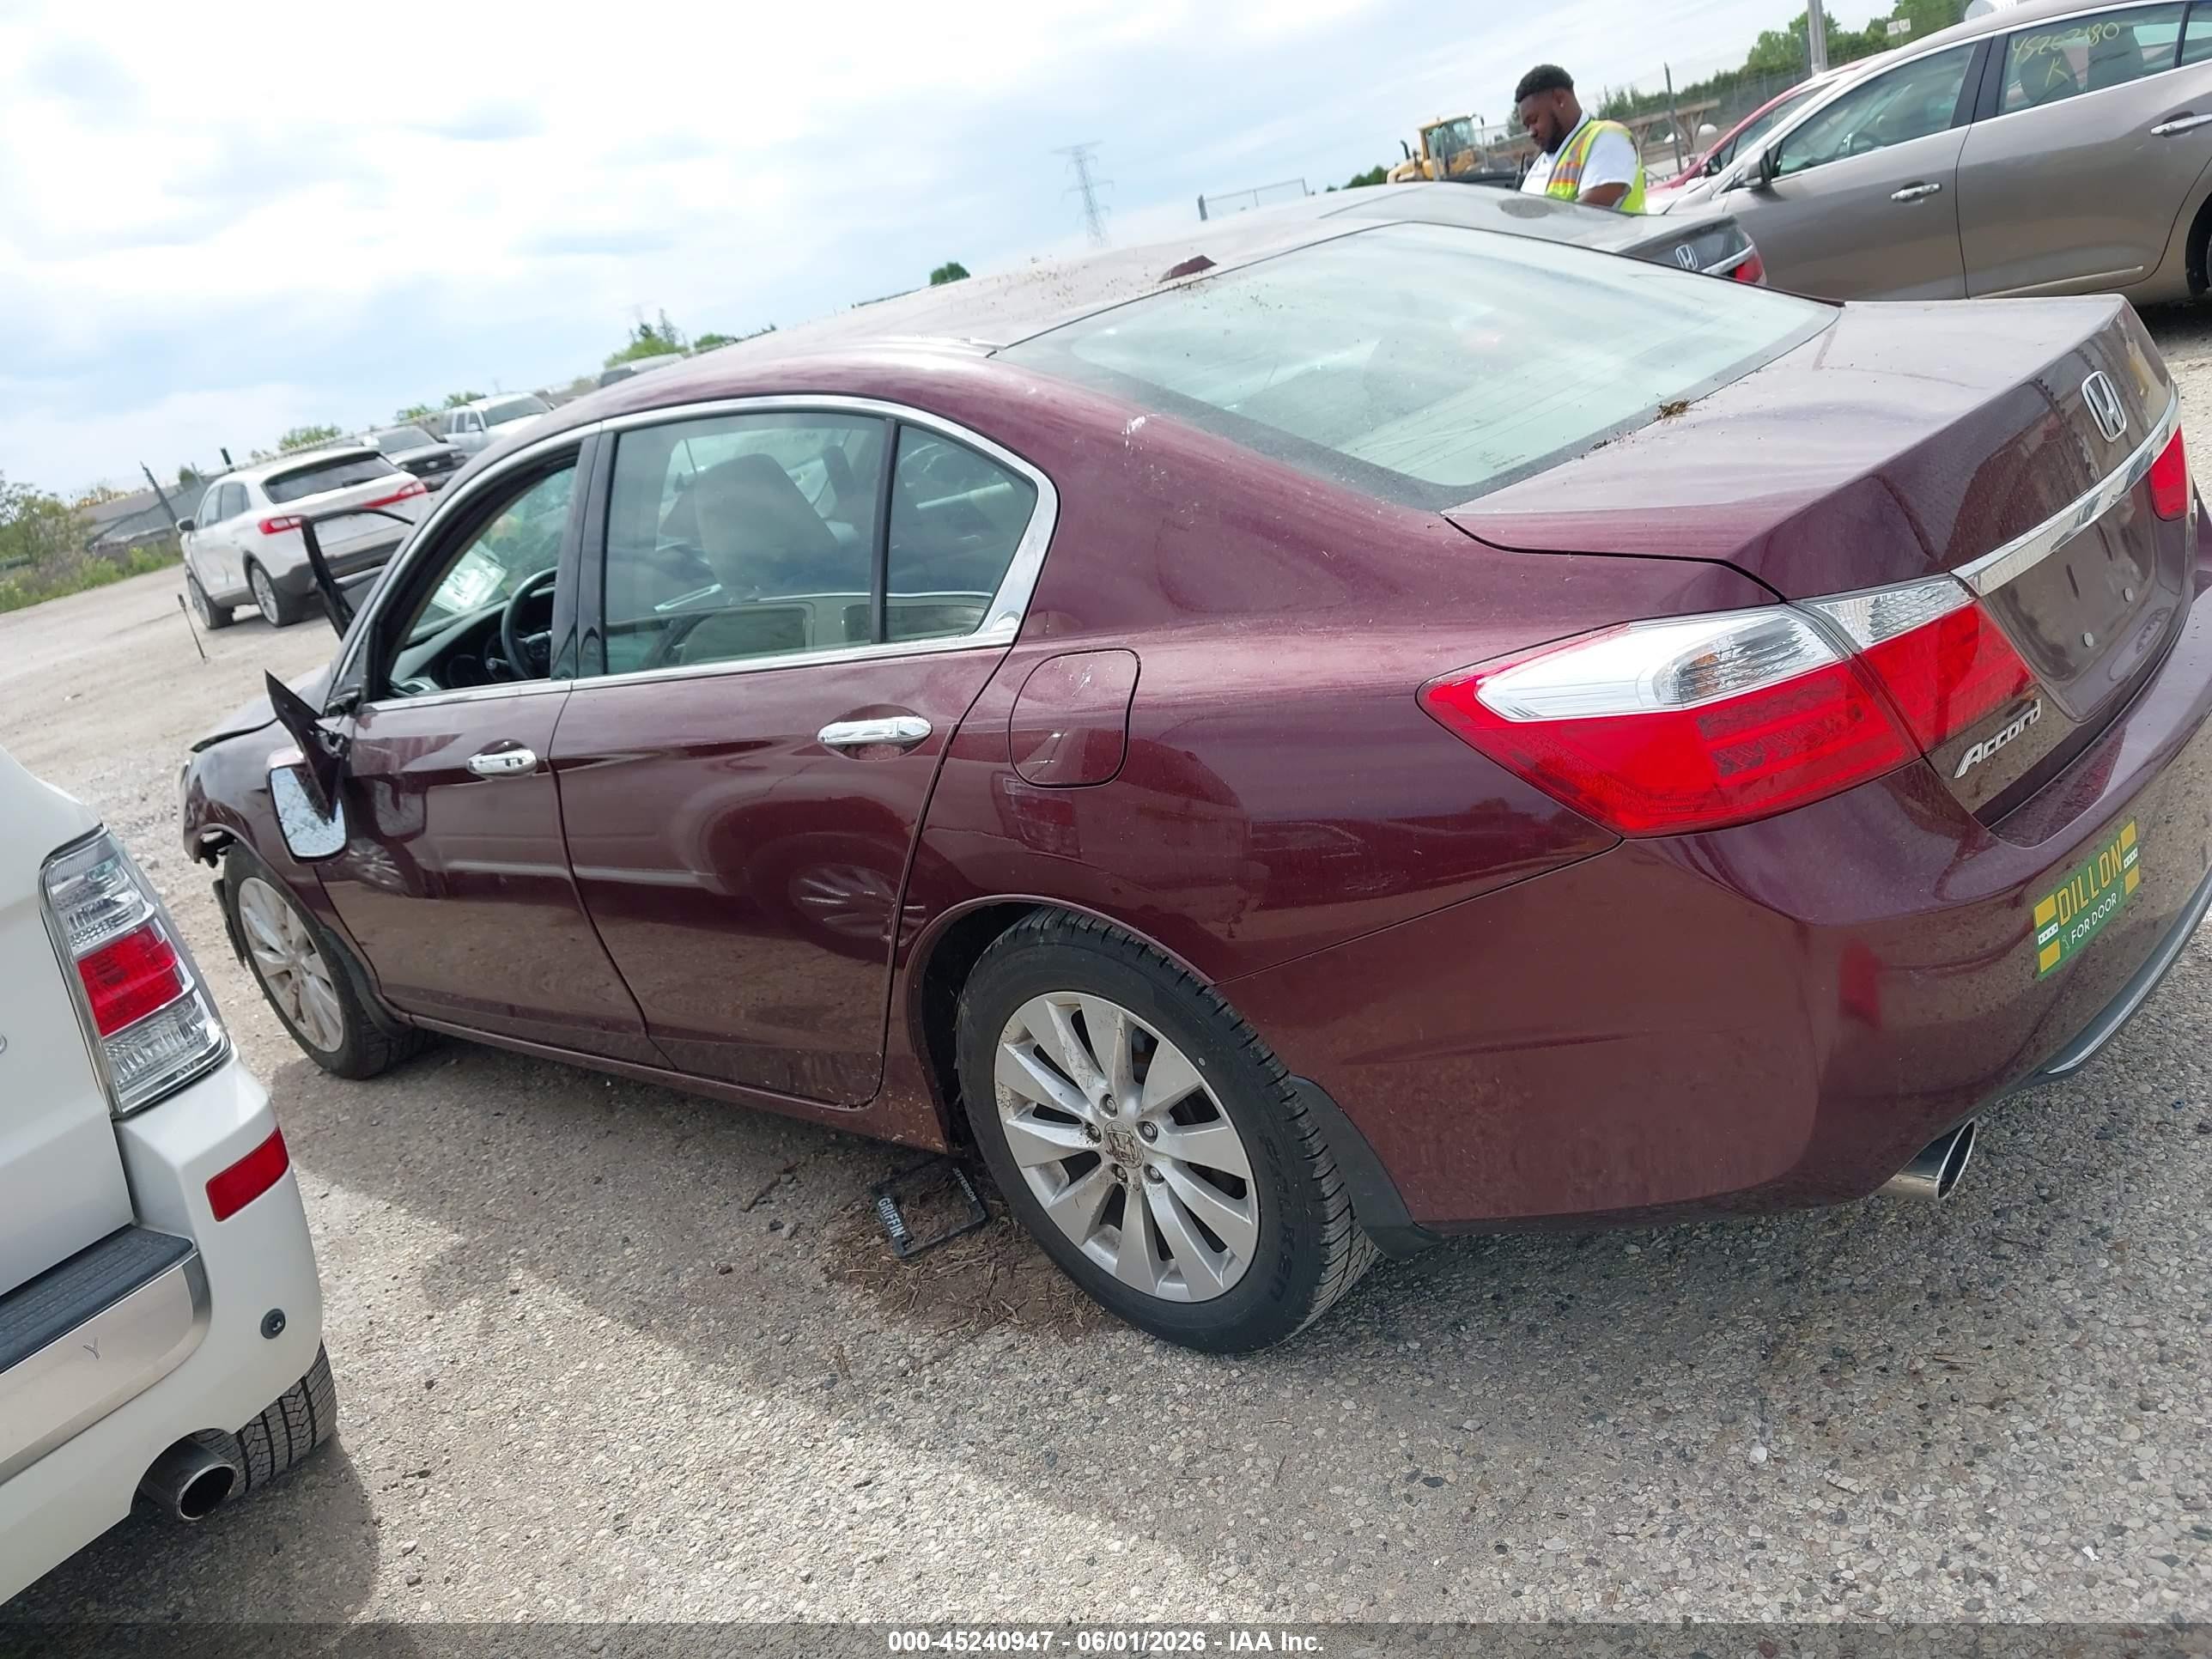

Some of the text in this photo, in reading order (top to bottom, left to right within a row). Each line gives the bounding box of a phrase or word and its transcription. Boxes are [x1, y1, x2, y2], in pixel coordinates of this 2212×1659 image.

[2045, 57, 2071, 88] K
[1954, 698, 2042, 779] Accord
[2057, 839, 2123, 927] DILLON
[2070, 891, 2118, 945] FOR DOOR
[952, 1167, 978, 1202] JEFFERSON
[878, 1196, 907, 1238] GRIFFIN
[1257, 1133, 1296, 1304] FALKEN
[82, 1337, 102, 1360] Y
